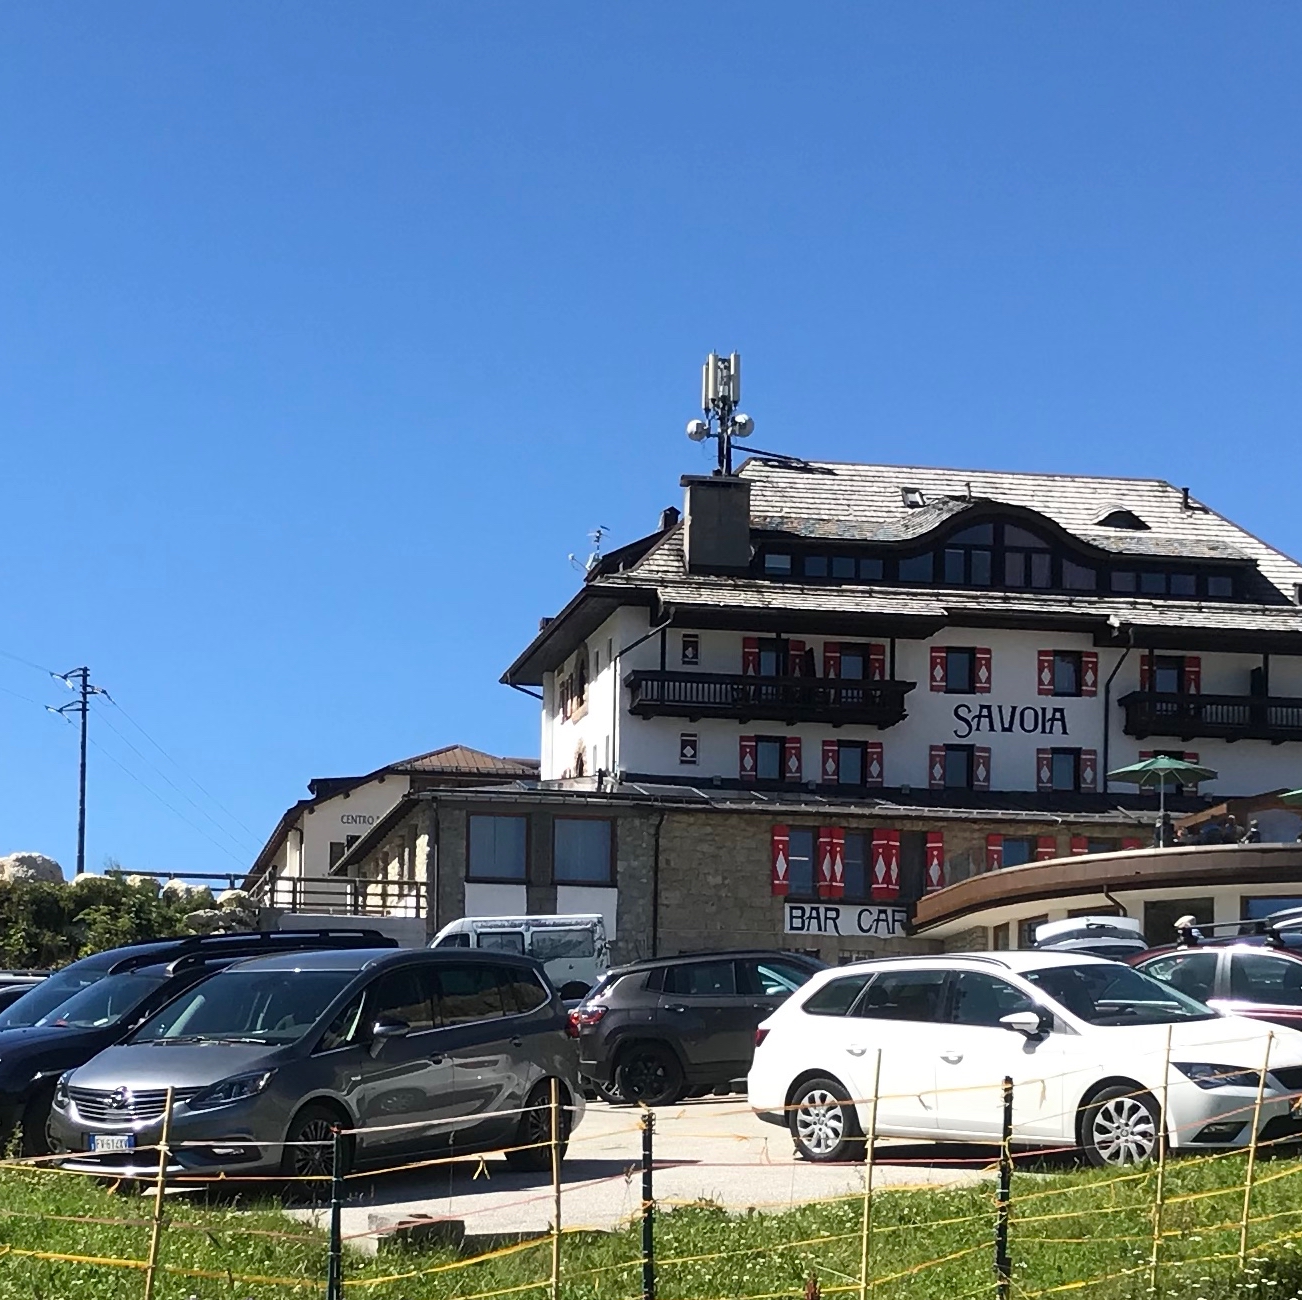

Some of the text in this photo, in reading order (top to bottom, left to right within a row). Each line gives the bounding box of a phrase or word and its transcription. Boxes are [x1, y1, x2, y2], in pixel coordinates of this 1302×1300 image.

[953, 703, 1069, 738] SAVOIA
[341, 814, 374, 825] CENTRO
[788, 905, 842, 936] BAR
